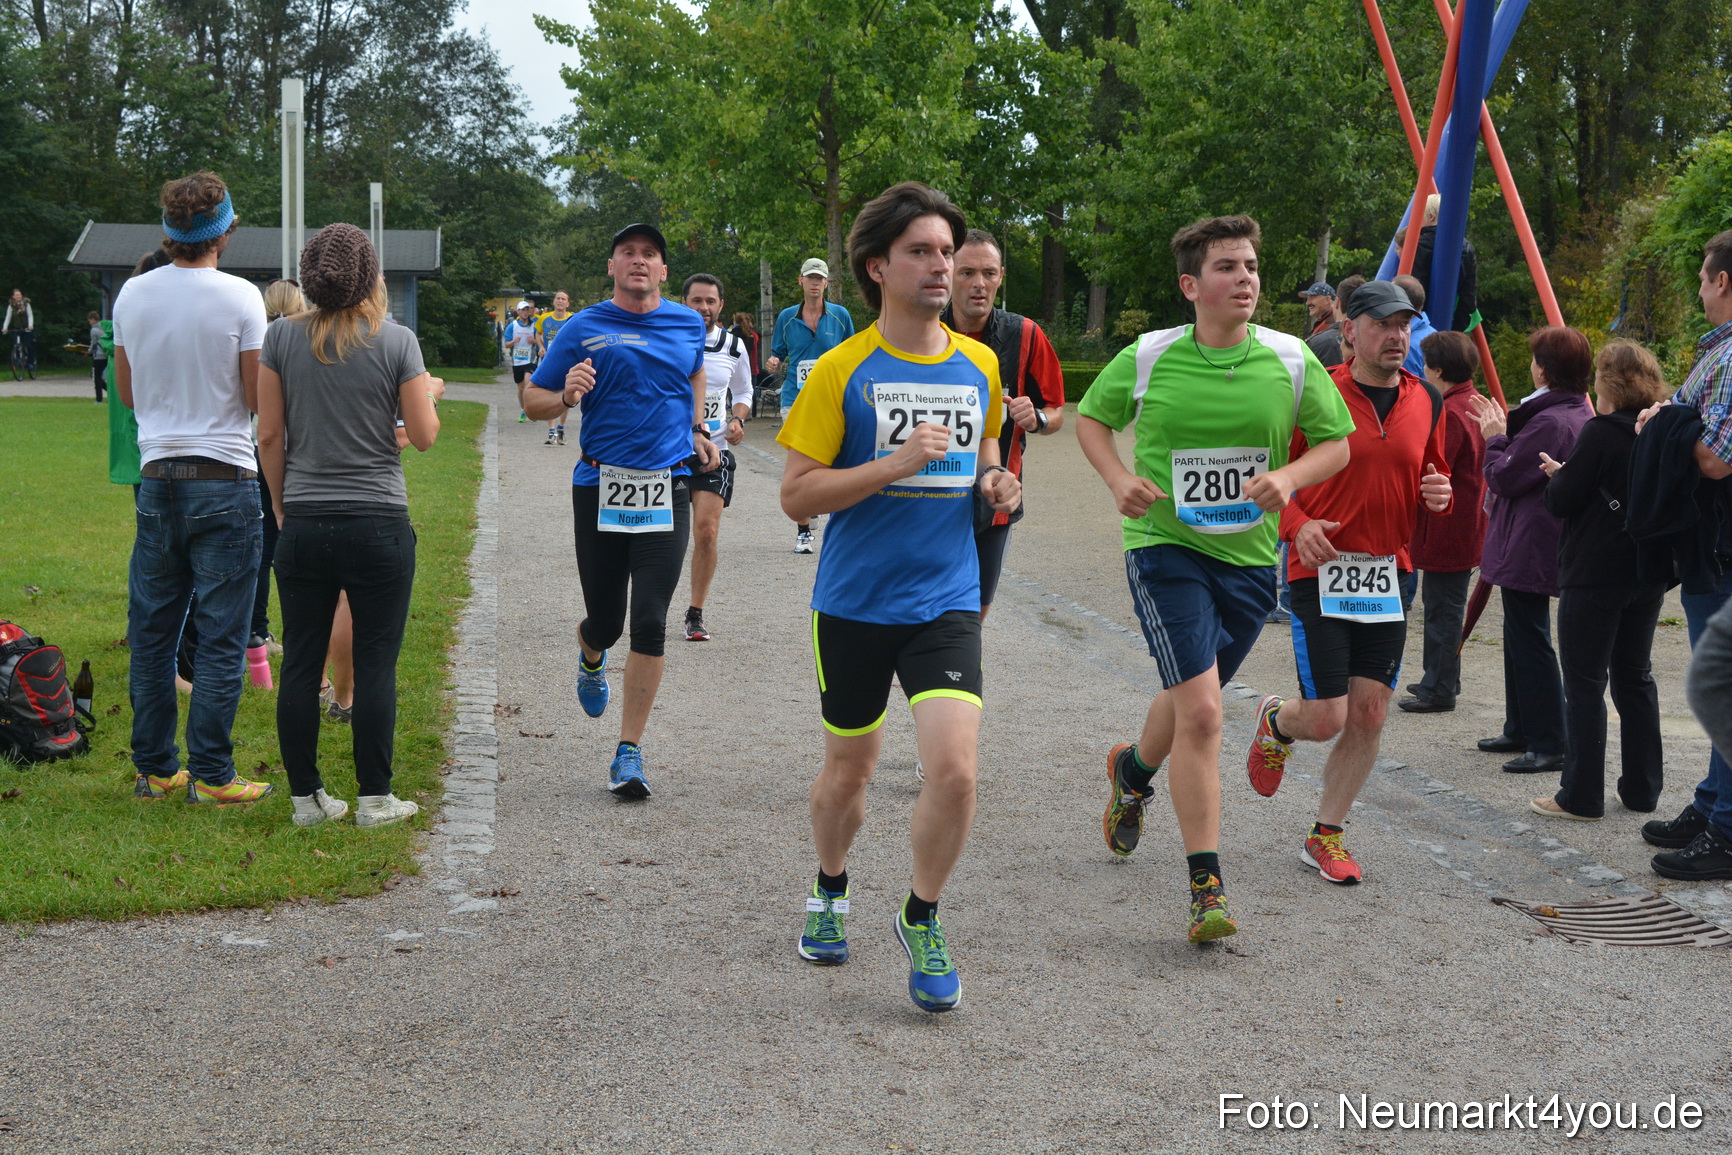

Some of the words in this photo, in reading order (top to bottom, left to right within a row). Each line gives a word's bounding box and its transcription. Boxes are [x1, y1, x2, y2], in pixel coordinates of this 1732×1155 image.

[877, 393, 913, 402] PARTL
[915, 394, 963, 404] Neumarkt
[921, 457, 961, 475] jamin
[1174, 457, 1207, 466] PARTL
[1208, 455, 1252, 466] Neumarkt
[601, 471, 626, 480] PARTL
[607, 481, 665, 507] 2212
[618, 513, 653, 524] Norbert
[1194, 507, 1252, 524] Christoph
[1327, 565, 1391, 594] 2845
[1339, 601, 1383, 612] Matthias
